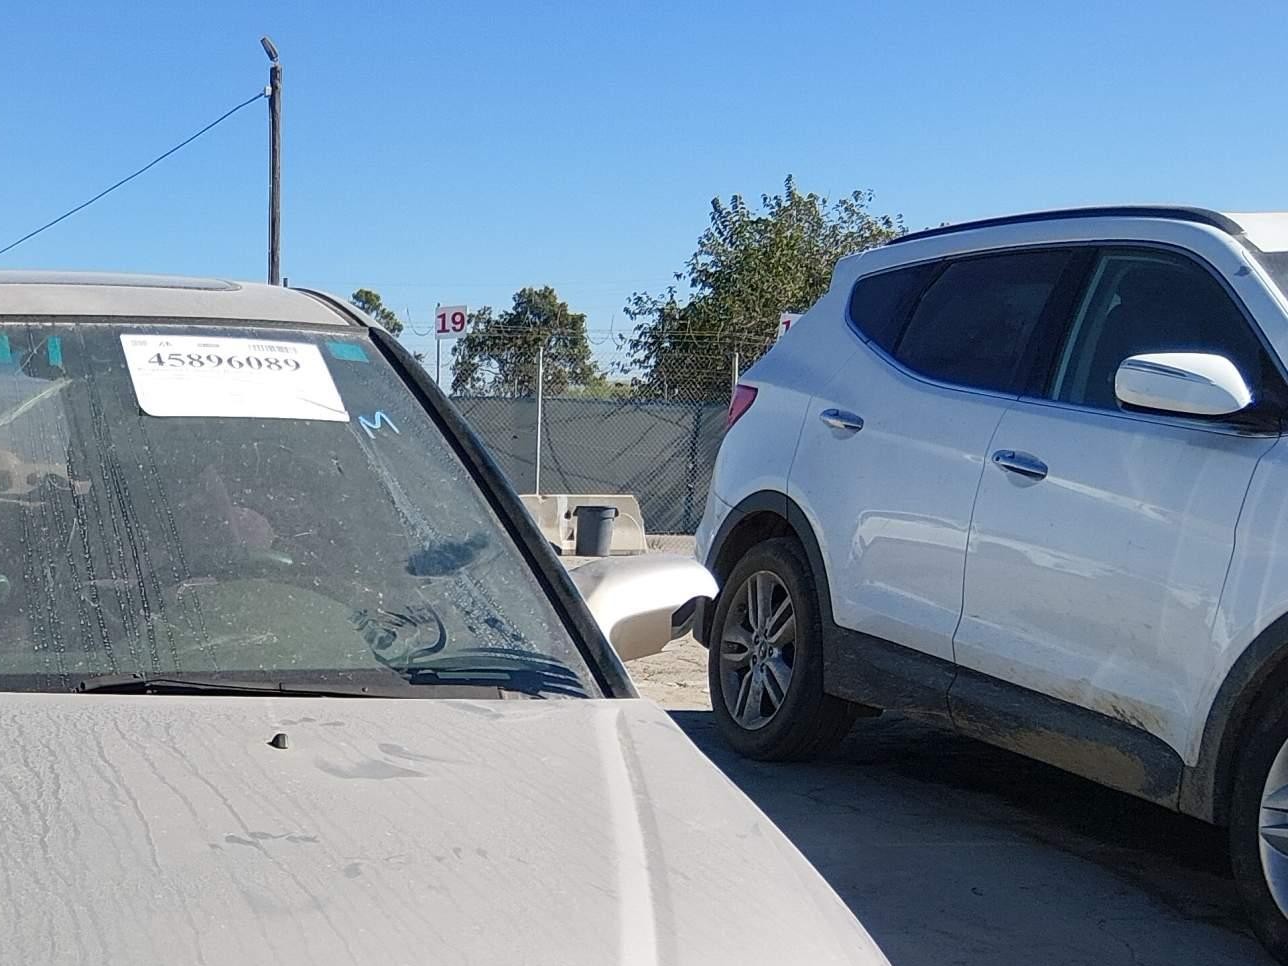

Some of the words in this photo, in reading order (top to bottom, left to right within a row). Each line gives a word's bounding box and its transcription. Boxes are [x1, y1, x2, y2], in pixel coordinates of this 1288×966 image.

[437, 312, 465, 333] 19
[148, 352, 301, 372] 45896089
[358, 410, 400, 439] M
